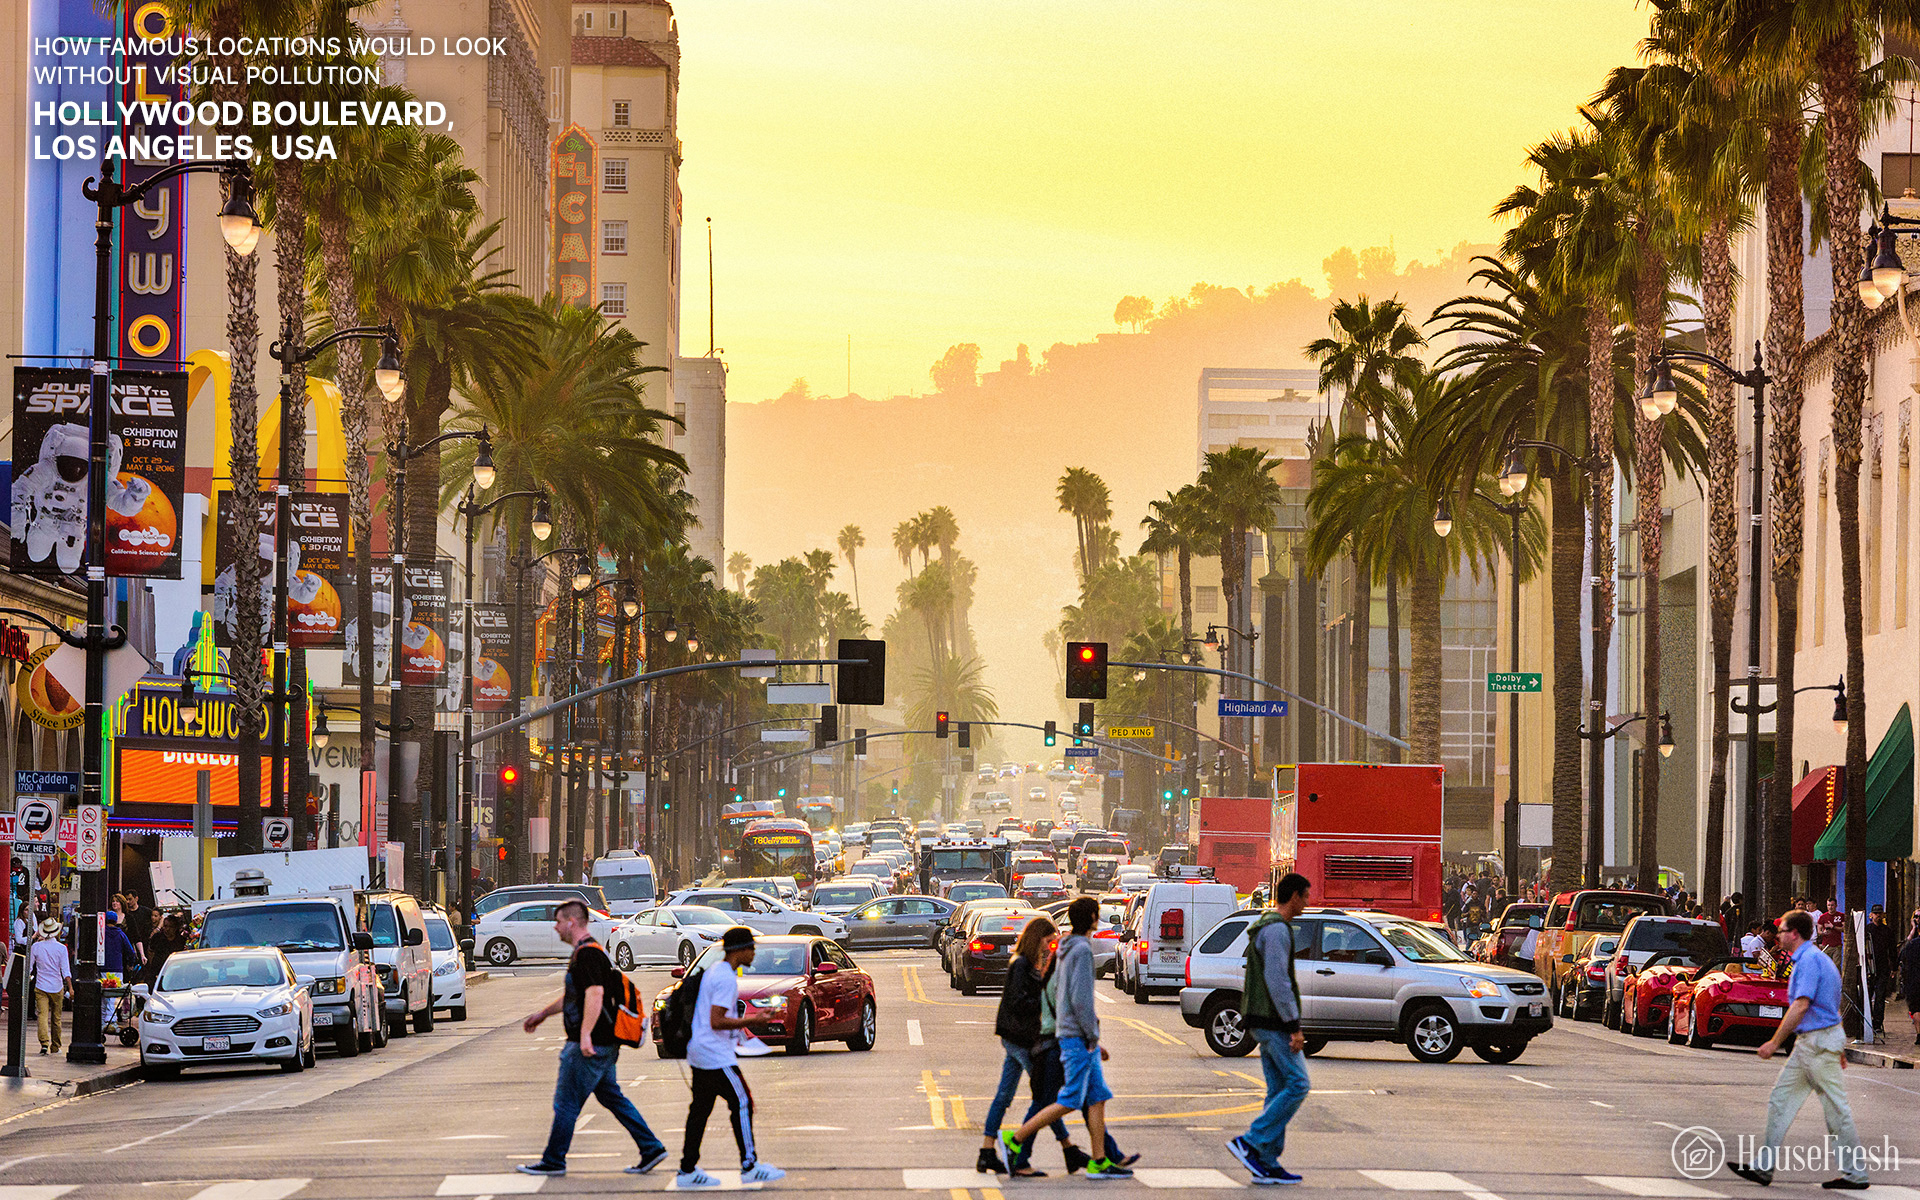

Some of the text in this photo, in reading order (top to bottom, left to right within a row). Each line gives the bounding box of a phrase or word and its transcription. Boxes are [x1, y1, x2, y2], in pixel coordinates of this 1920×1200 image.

[557, 153, 592, 186] EL
[26, 394, 175, 417] SPACE
[122, 427, 178, 438] EXHIBITION
[124, 438, 176, 449] & 3D FILM
[300, 535, 342, 544] EXHIBITION
[1495, 675, 1522, 683] Dolby
[1491, 683, 1527, 691] Theatre
[1224, 703, 1284, 713] Highland Av
[30, 708, 85, 729] Since 1989
[1111, 728, 1151, 737] PED XING
[18, 774, 69, 785] McCadden
[17, 783, 34, 791] 1700
[753, 836, 768, 845] 780
[16, 843, 54, 854] PAY HERE
